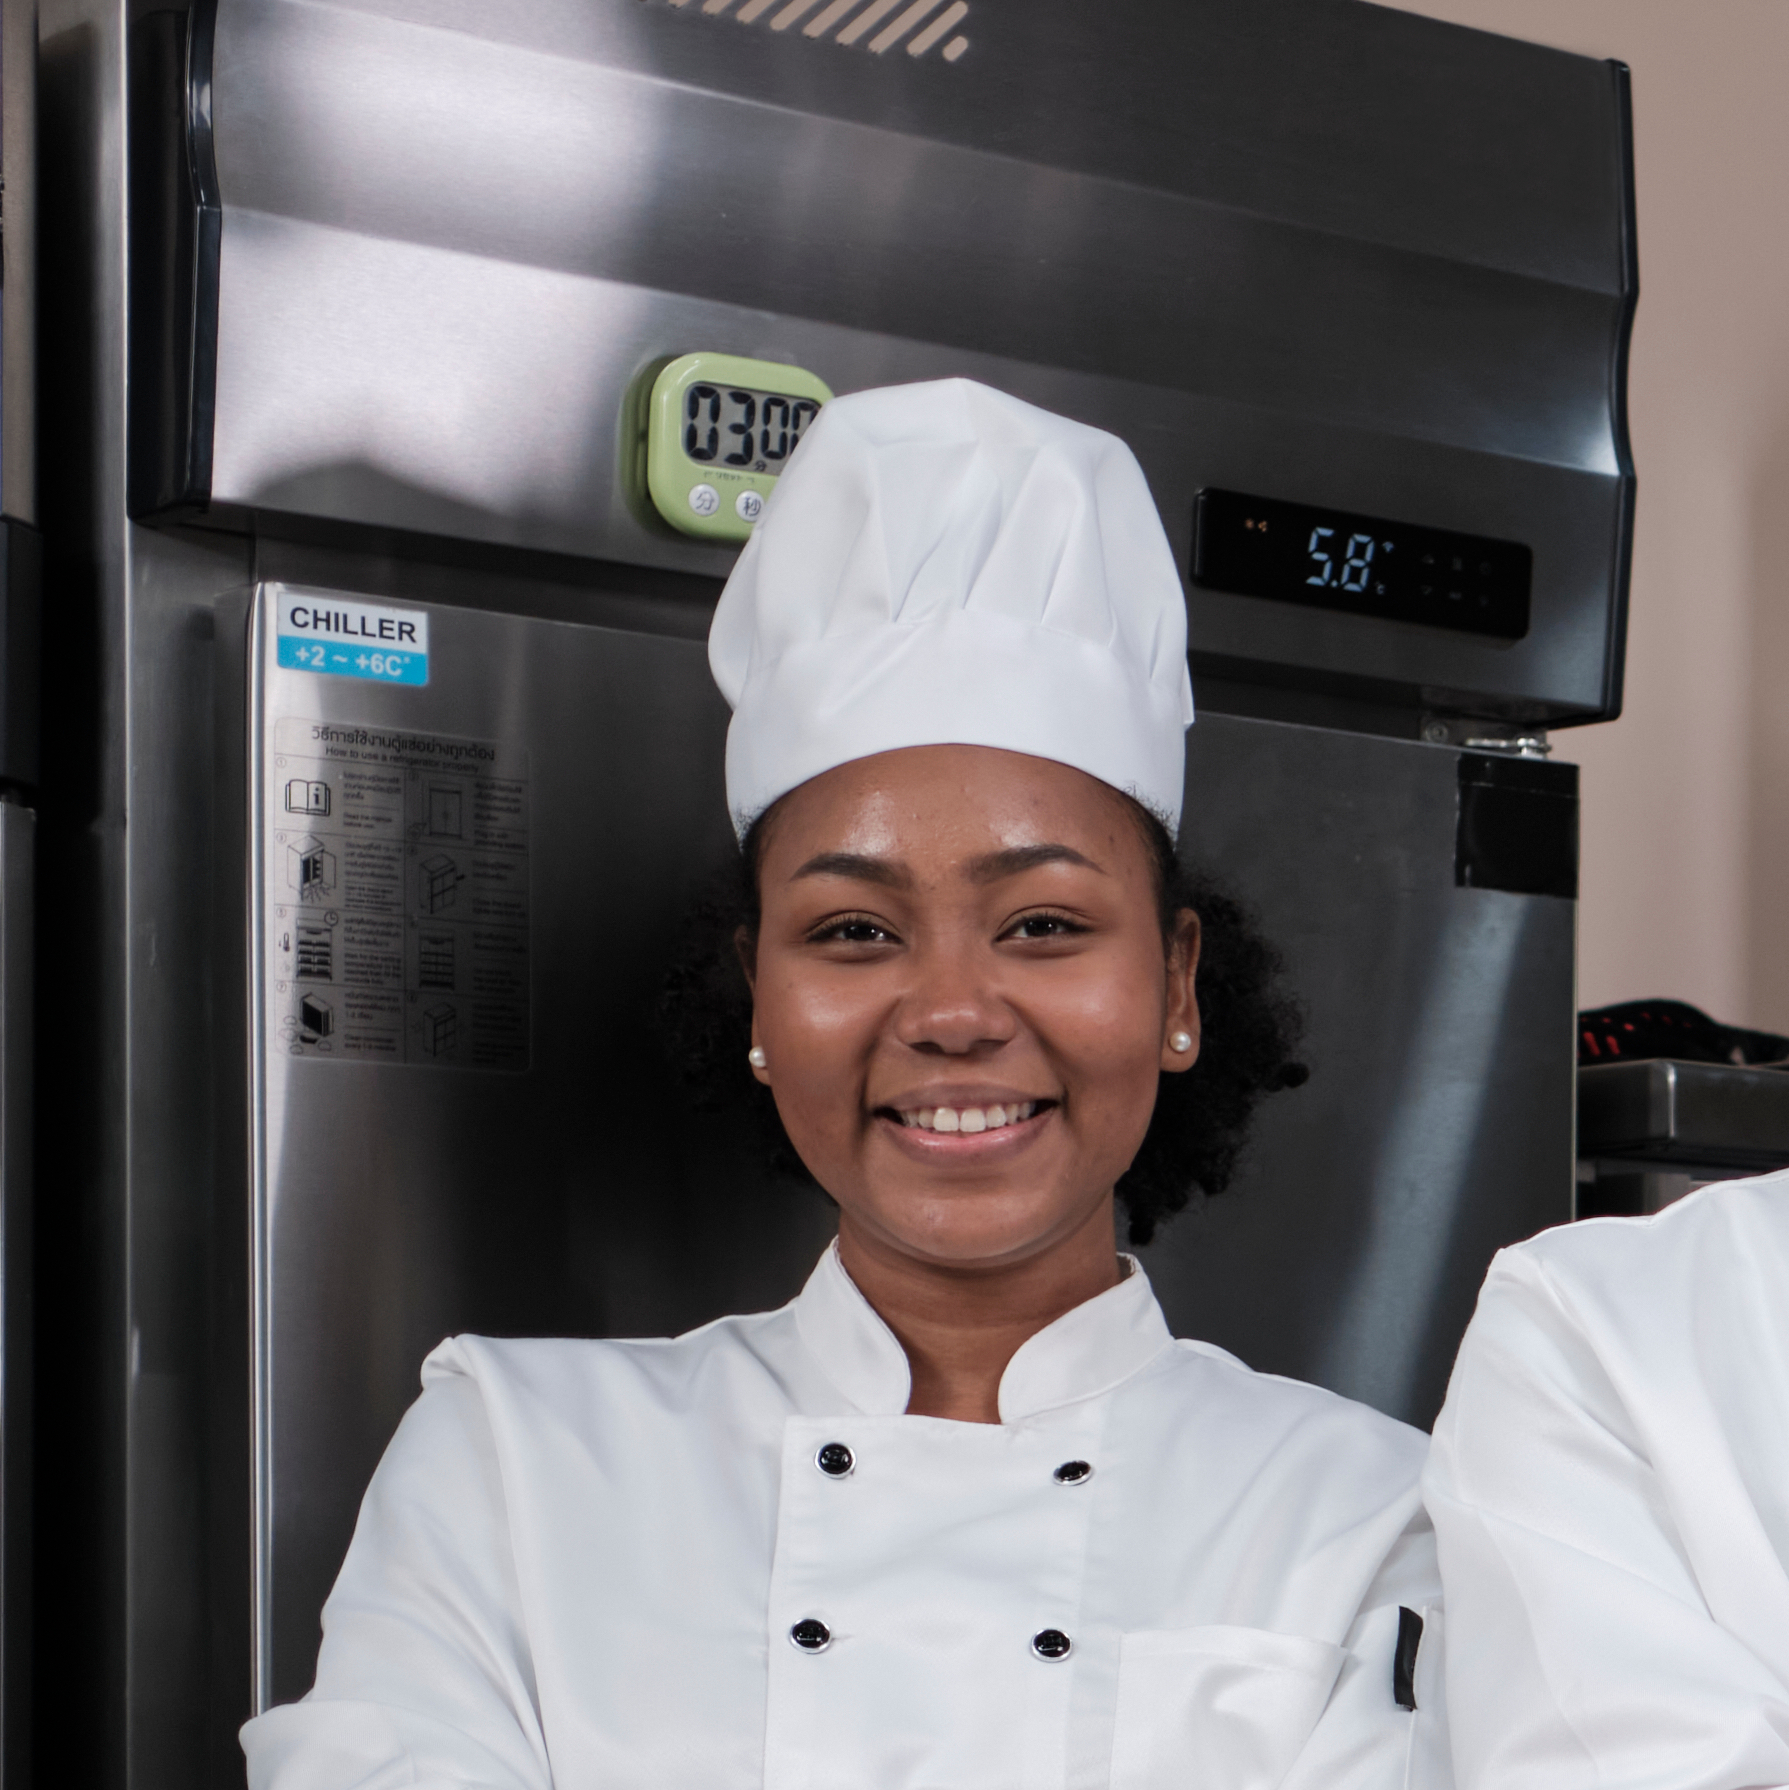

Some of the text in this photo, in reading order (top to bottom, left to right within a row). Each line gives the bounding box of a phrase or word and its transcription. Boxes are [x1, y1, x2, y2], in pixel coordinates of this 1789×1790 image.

[695, 491, 715, 511] 分
[742, 496, 762, 517] 秒
[1305, 526, 1376, 593] 5.8
[290, 606, 417, 643] CHILLER
[295, 646, 326, 667] +2
[325, 746, 348, 758] How
